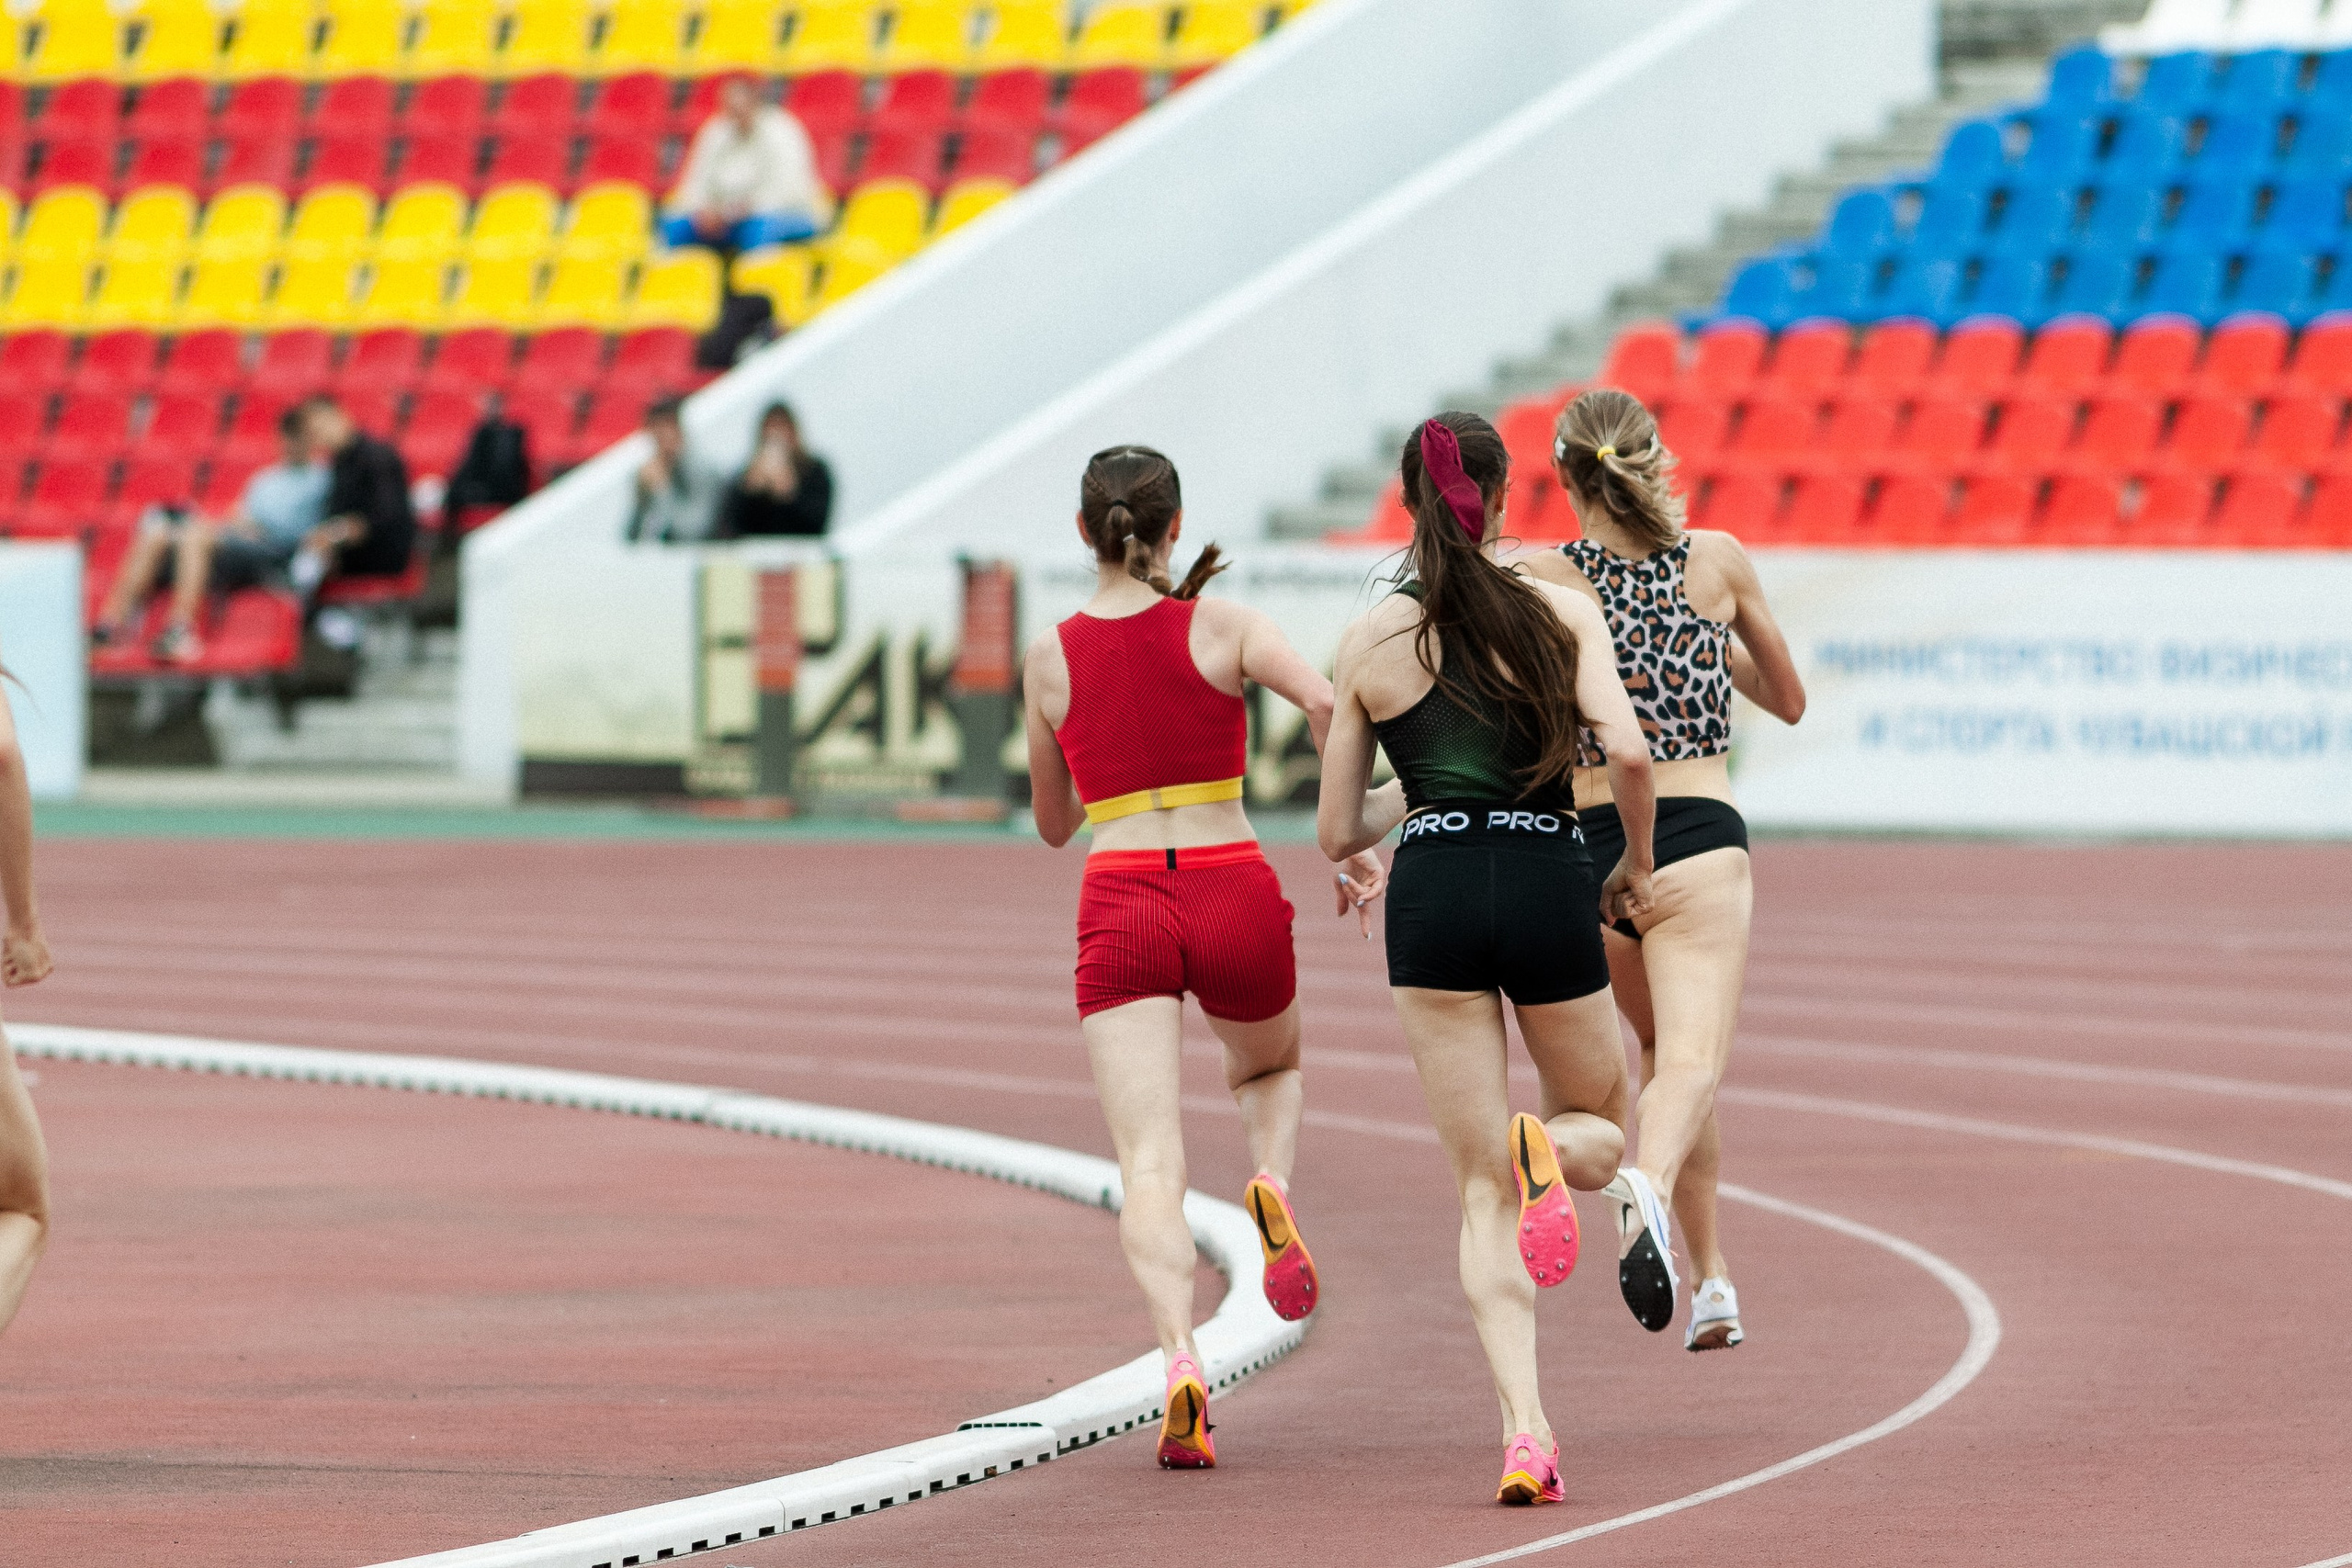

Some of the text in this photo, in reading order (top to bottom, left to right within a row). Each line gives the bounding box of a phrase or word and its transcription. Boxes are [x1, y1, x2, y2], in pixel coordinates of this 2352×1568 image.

[1900, 709, 2056, 758] СПОРТА
[1403, 811, 1559, 842] PRO PRO
